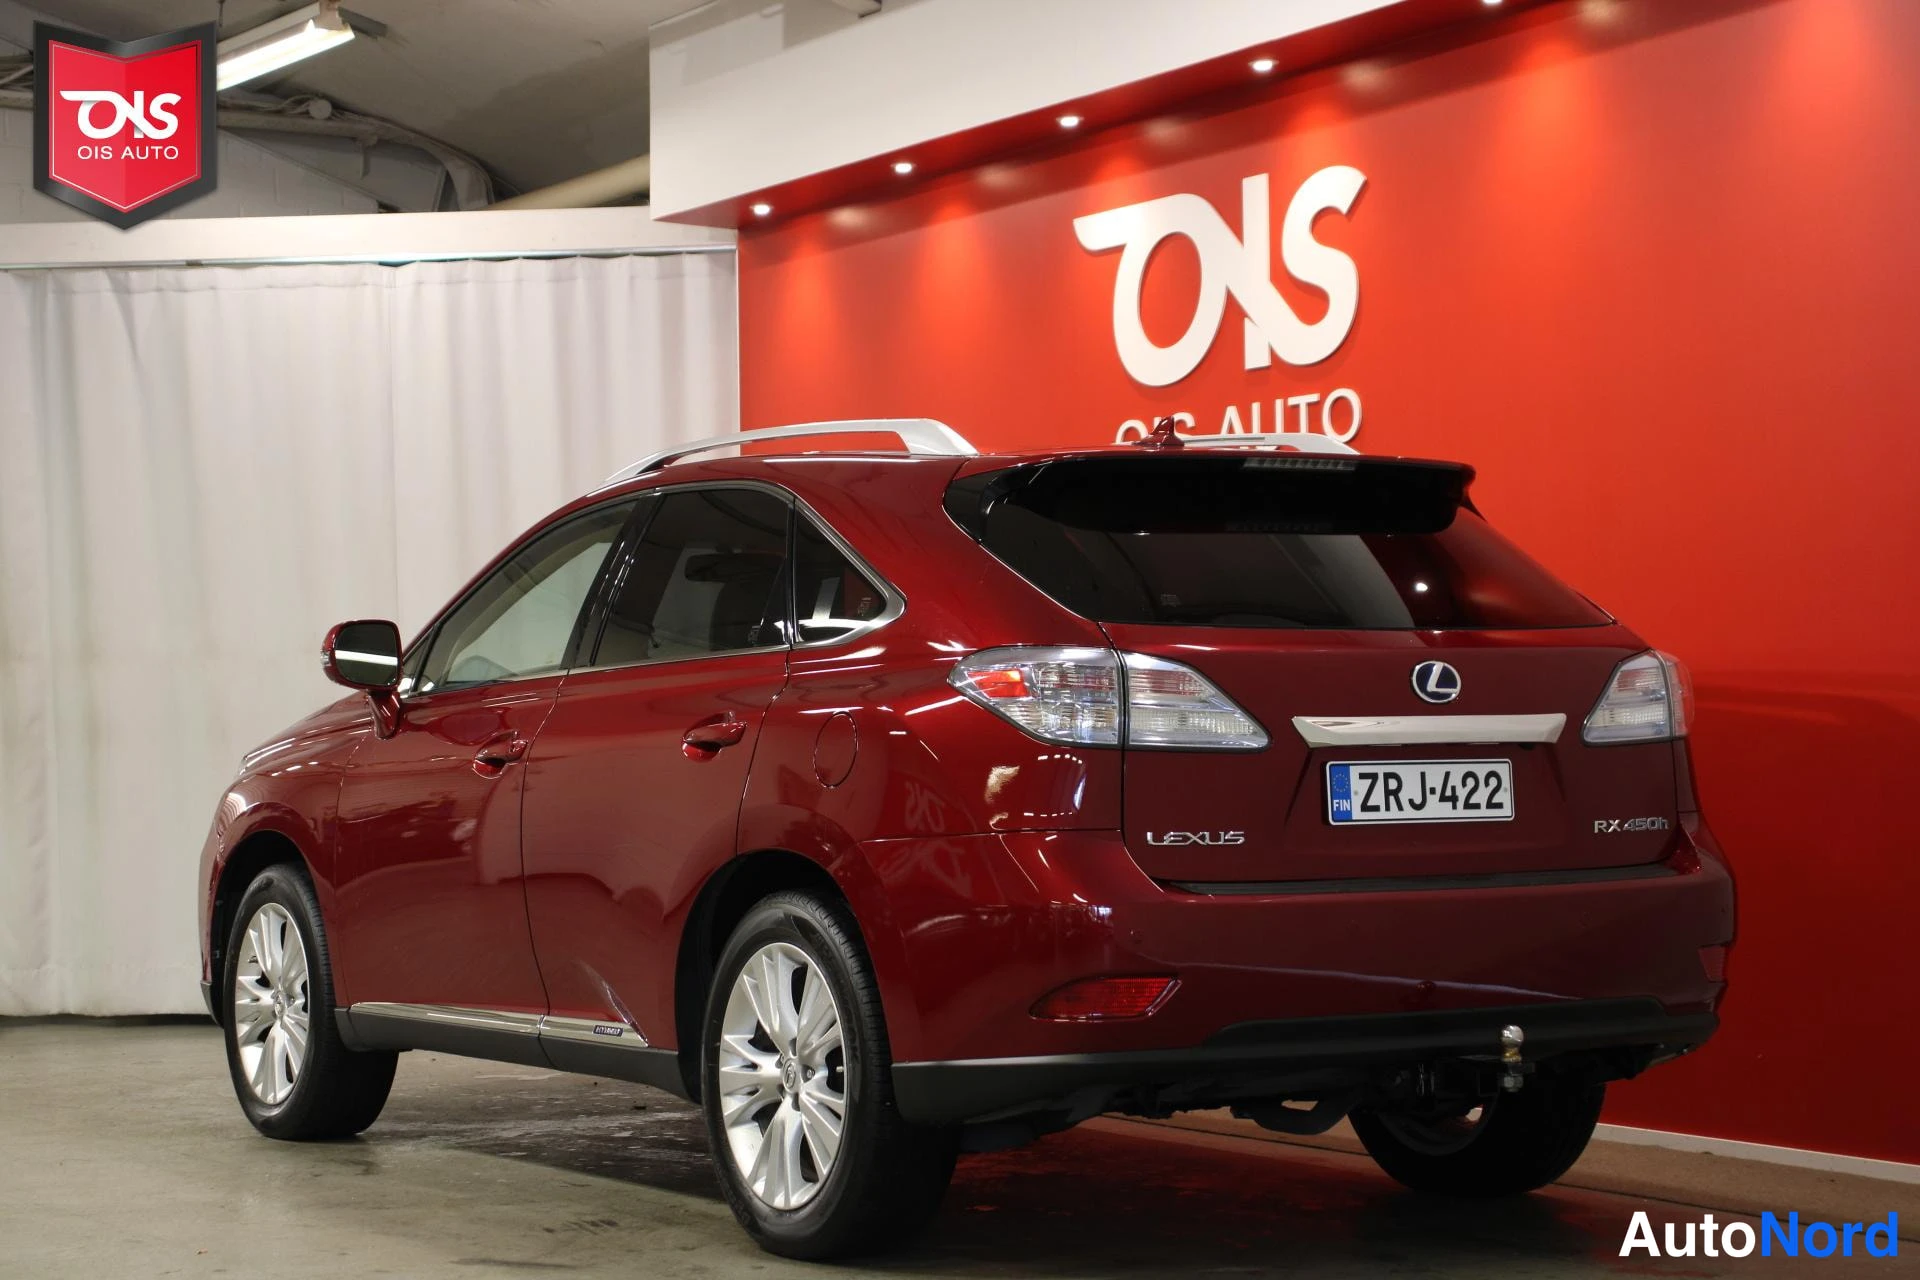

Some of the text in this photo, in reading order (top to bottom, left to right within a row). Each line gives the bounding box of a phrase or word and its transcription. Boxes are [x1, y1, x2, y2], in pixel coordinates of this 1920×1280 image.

[1358, 770, 1504, 813] ZRJ-422
[1333, 799, 1351, 812] FIN
[1594, 817, 1669, 833] RX 450h
[1146, 831, 1245, 846] LEXUS
